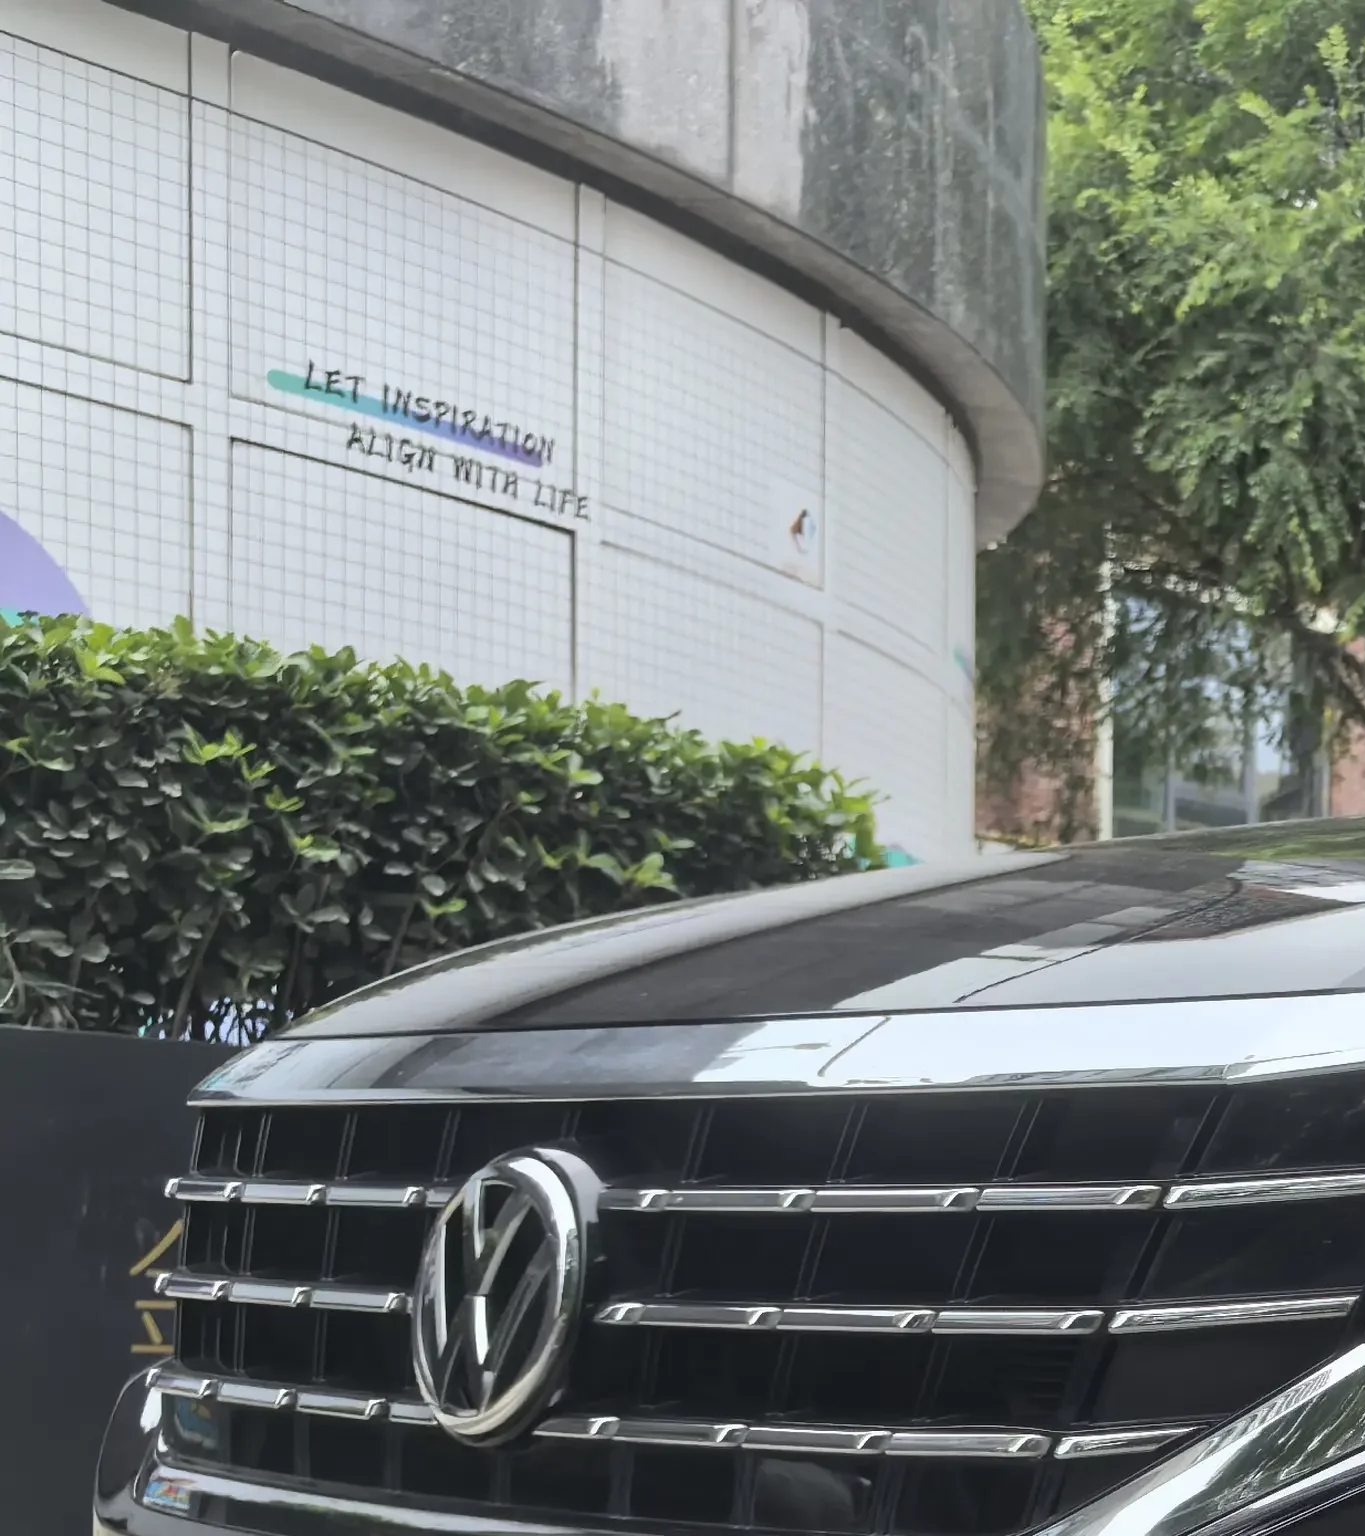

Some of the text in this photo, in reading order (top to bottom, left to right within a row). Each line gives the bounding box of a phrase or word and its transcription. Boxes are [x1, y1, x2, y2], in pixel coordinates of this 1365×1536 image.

[304, 359, 556, 464] LET INSPIRATION
[346, 422, 592, 521] ALIGN WITH LIFE
